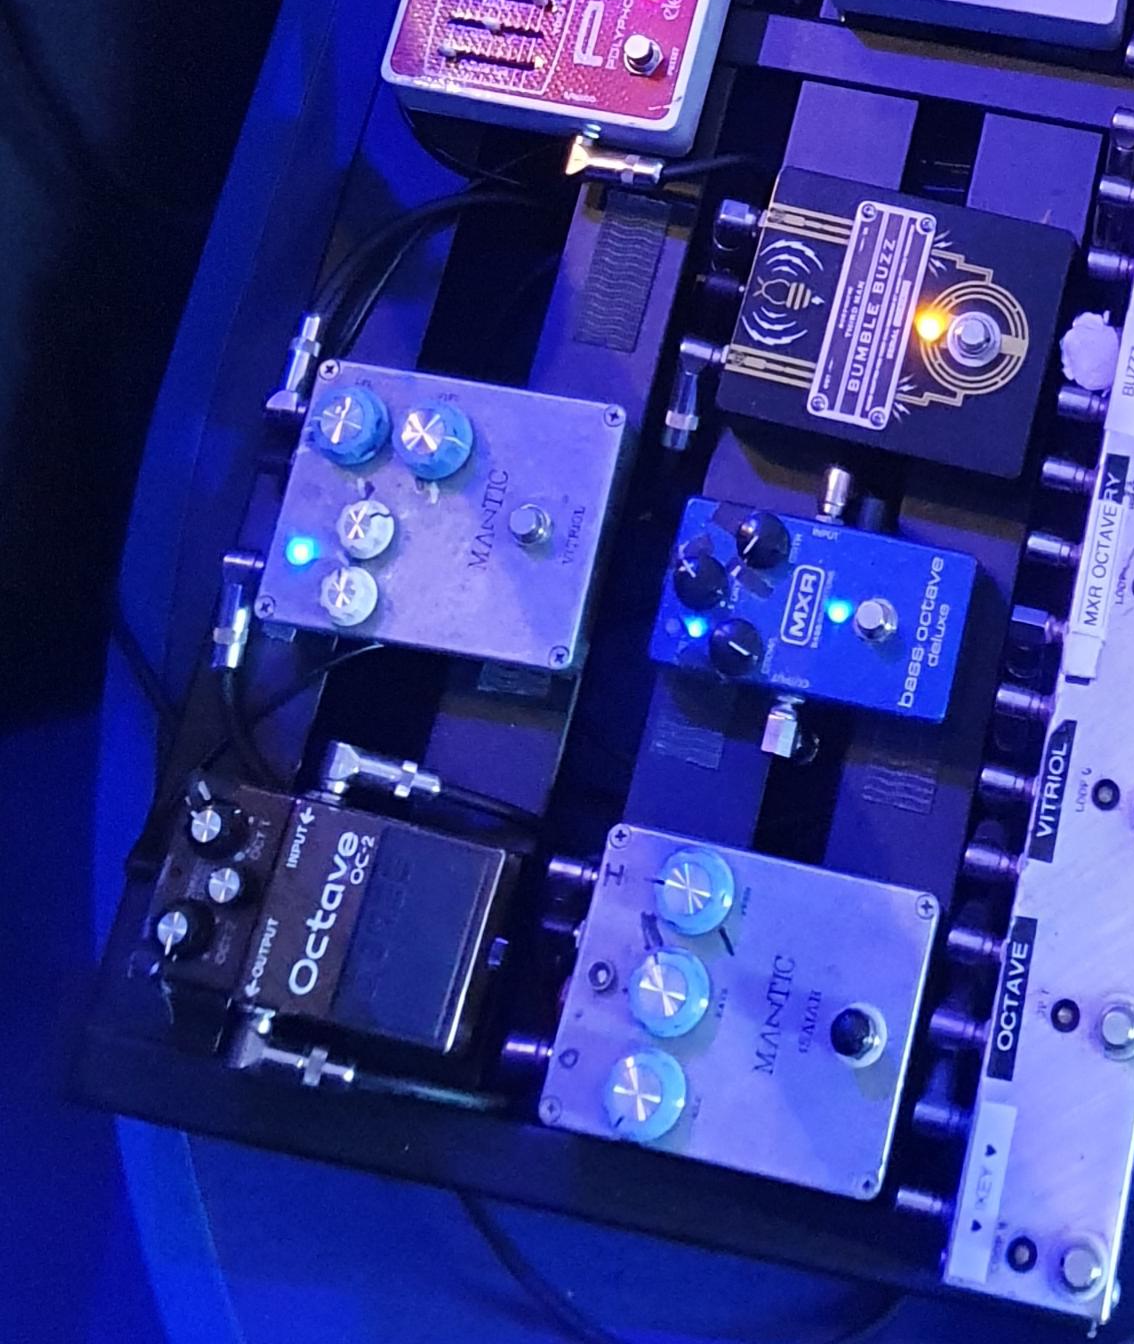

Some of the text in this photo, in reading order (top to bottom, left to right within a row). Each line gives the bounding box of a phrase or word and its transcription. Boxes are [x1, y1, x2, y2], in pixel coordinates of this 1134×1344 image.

[848, 303, 879, 391] BUMBLE
[872, 239, 896, 294] BUZZ
[469, 468, 508, 571] MANTIC
[812, 527, 839, 541] INPUT
[1083, 505, 1117, 626] MXR OCTAVE
[789, 574, 815, 637] MXR
[898, 557, 943, 707] bass octave
[928, 604, 950, 667] deluxe
[1036, 743, 1067, 838] VITRIOL
[286, 824, 309, 869] INPUT
[350, 835, 375, 885] OC-2
[251, 917, 279, 978] OUTPUT
[288, 831, 359, 995] Octave
[754, 954, 796, 1075] MANTIC
[997, 941, 1029, 1051] OCTAVE
